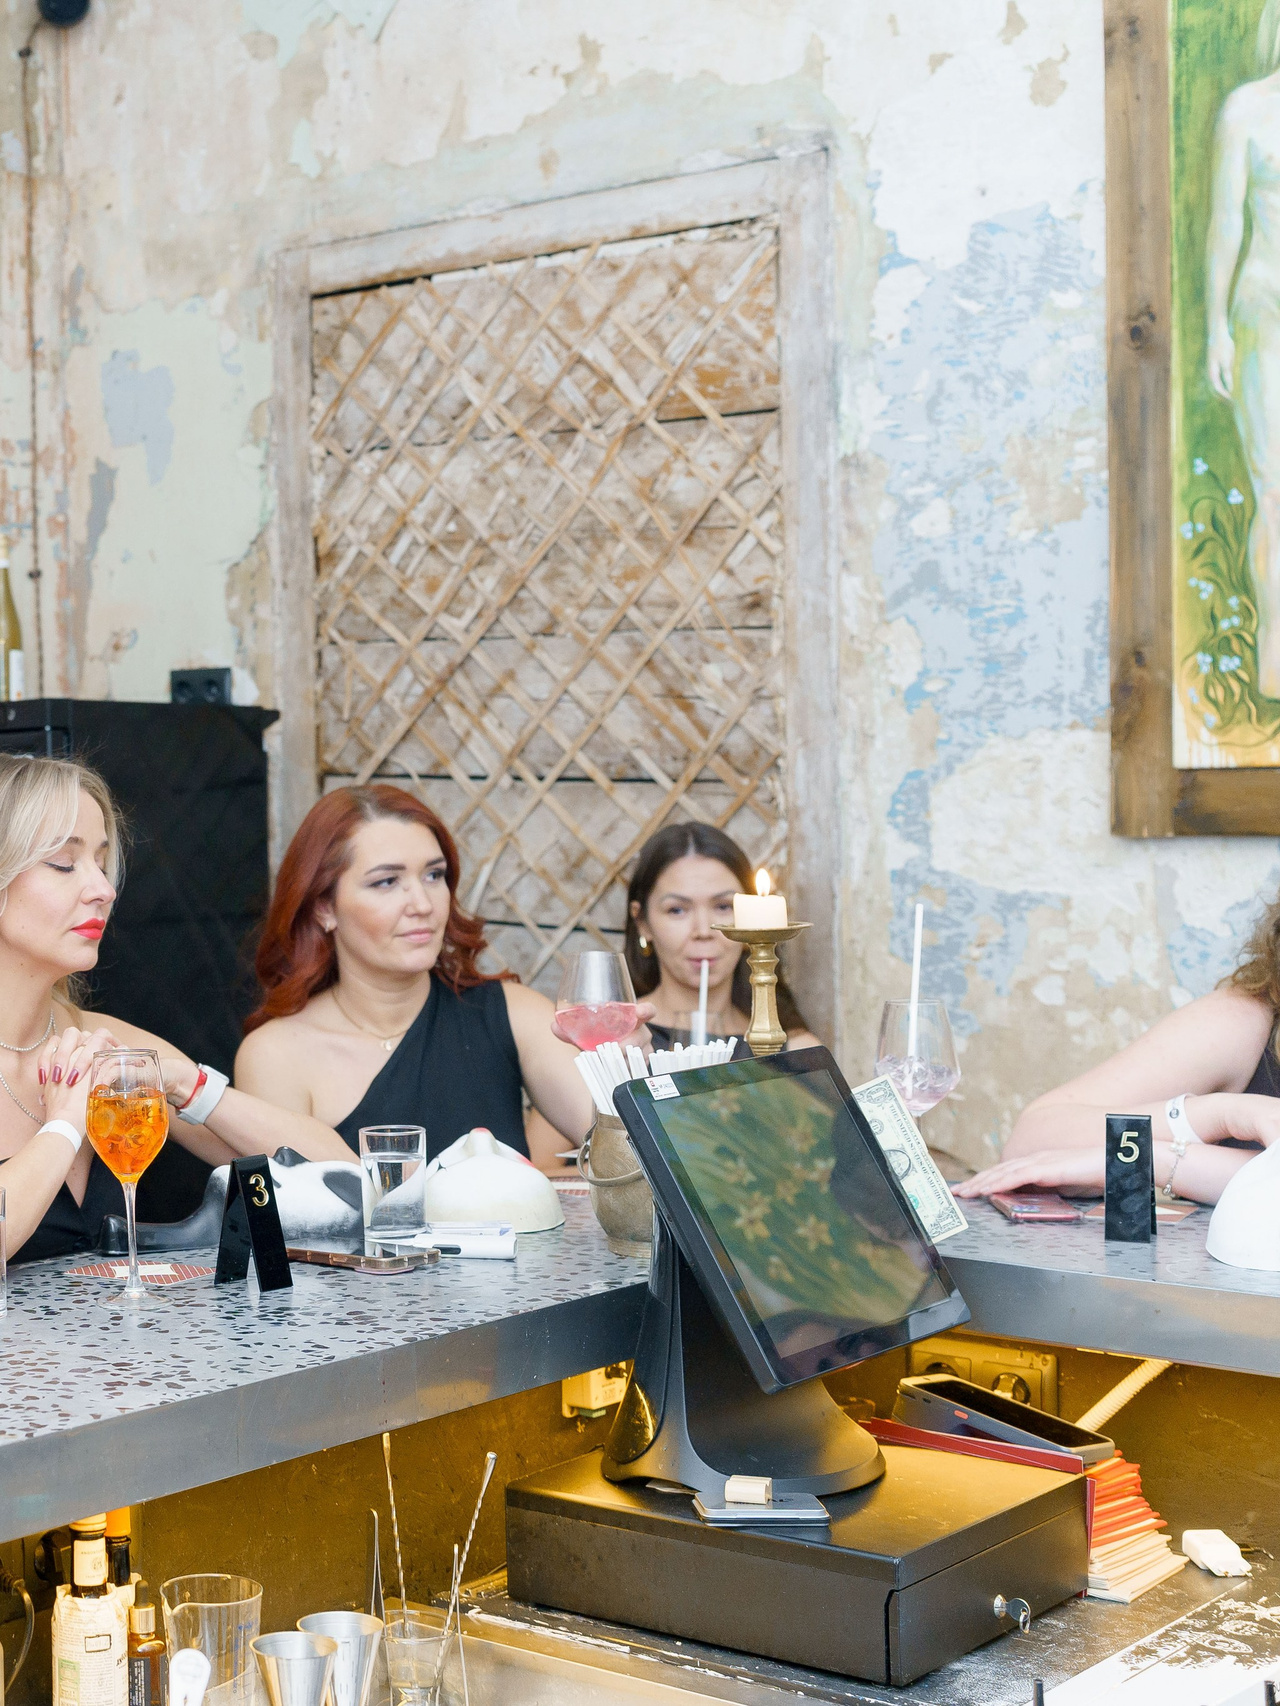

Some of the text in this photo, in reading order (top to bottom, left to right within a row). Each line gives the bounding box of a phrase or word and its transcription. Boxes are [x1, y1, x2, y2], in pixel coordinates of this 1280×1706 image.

[888, 1104, 899, 1119] THE
[895, 1118, 912, 1143] UNITED
[907, 1141, 924, 1167] STATES
[920, 1165, 929, 1176] OF
[925, 1174, 945, 1205] AMERICA
[1117, 1131, 1140, 1163] 5
[249, 1173, 269, 1207] 3
